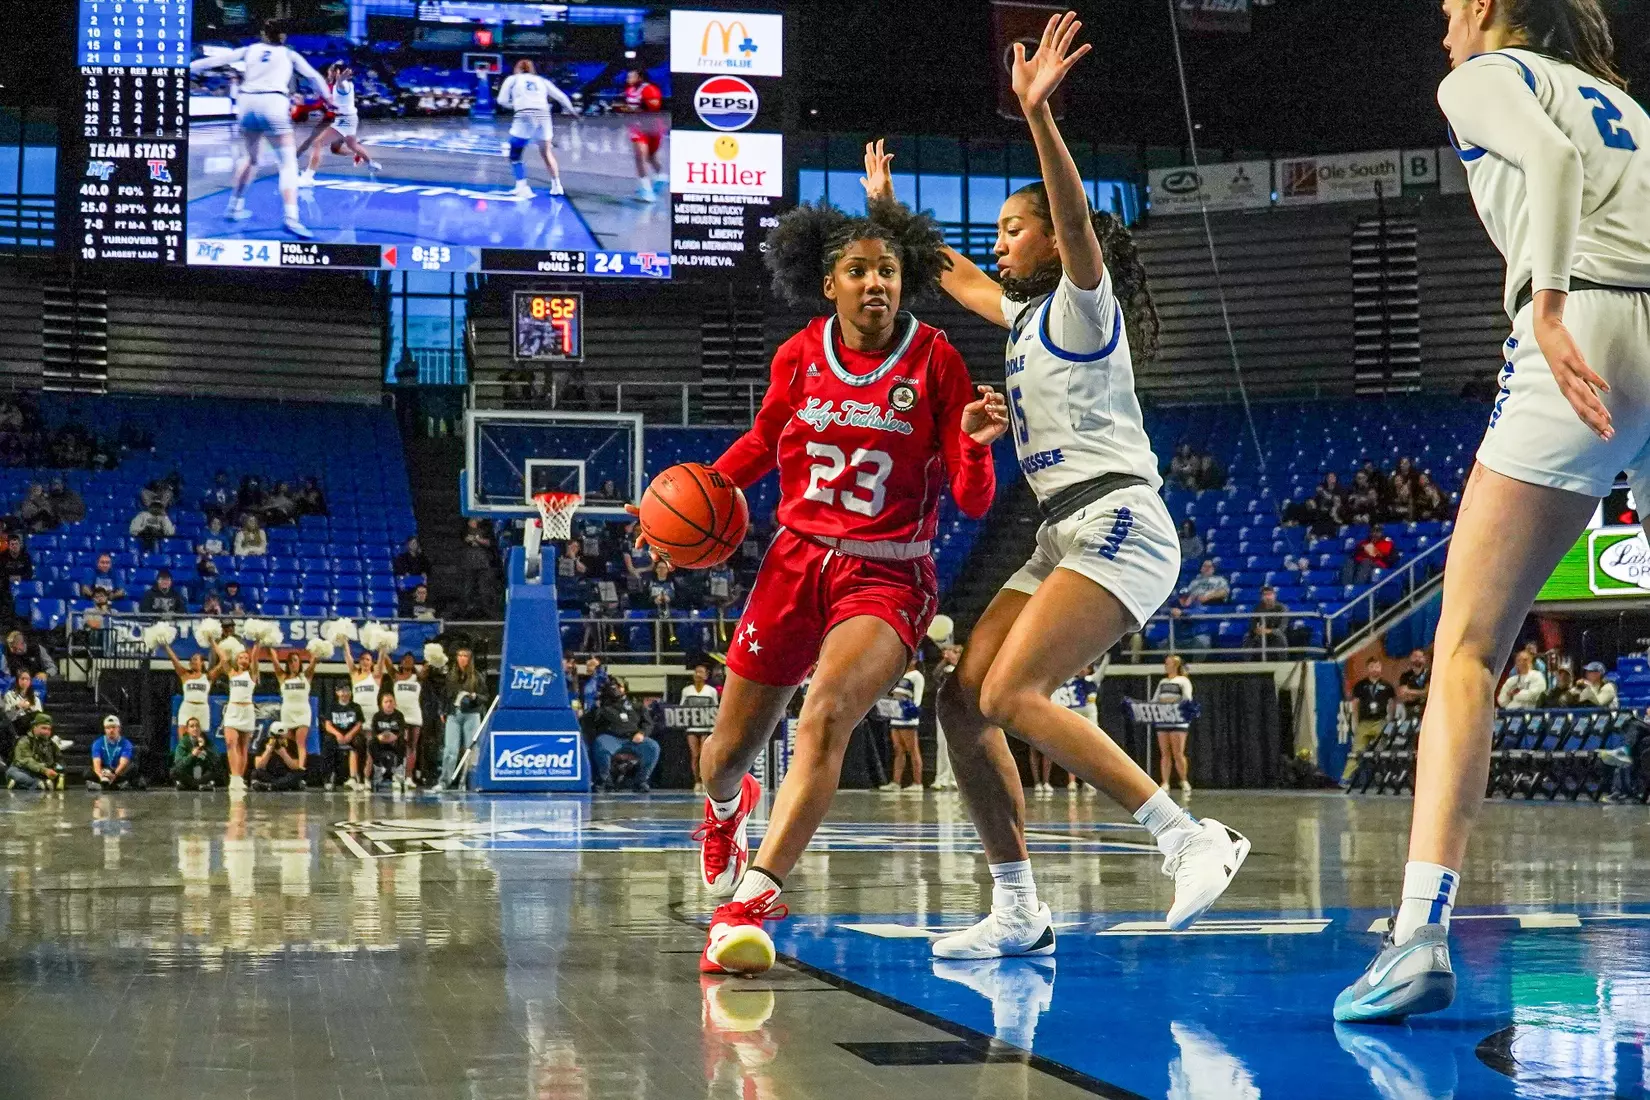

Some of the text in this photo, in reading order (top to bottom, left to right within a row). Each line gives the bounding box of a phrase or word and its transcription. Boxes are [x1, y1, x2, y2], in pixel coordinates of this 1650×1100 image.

[92, 3, 98, 12] 1
[138, 4, 144, 13] 1
[160, 5, 166, 14] 1
[178, 5, 185, 14] 2
[90, 16, 97, 25] 2
[112, 16, 125, 26] 11
[160, 17, 165, 26] 1
[178, 18, 184, 27] 1
[88, 28, 100, 37] 10
[178, 30, 184, 39] 1
[87, 41, 100, 50] 15
[137, 41, 143, 51] 1
[177, 42, 184, 52] 2
[87, 53, 99, 63] 21
[159, 55, 164, 64] 1
[177, 55, 184, 64] 2
[81, 67, 103, 75] PLYR
[108, 67, 124, 75] PTS
[130, 67, 147, 75] REB
[152, 68, 169, 76] AST
[89, 77, 96, 87] 3
[114, 77, 120, 87] 1
[176, 78, 184, 88] 2
[86, 89, 99, 99] 15
[112, 90, 120, 99] 3
[158, 91, 164, 100] 1
[176, 91, 184, 101] 2
[112, 102, 120, 112] 2
[135, 103, 142, 113] 2
[158, 103, 164, 113] 1
[177, 104, 183, 113] 1
[699, 97, 755, 110] PEPSI
[84, 114, 99, 124] 22
[112, 115, 120, 125] 5
[134, 115, 142, 125] 4
[158, 116, 164, 125] 1
[1578, 86, 1640, 152] 2
[84, 127, 98, 137] 23
[109, 127, 122, 137] 12
[135, 127, 141, 137] 1
[89, 143, 177, 159] TEAM STATS
[687, 162, 766, 186] Hiller
[1350, 159, 1396, 178] South
[80, 184, 182, 197] 40.0 FG% 22.7
[712, 195, 770, 205] BASKETBALL
[80, 202, 181, 214] 25.0 3PT% 44.4
[708, 205, 744, 215] KENTUCKY
[152, 220, 182, 231] 10-12
[709, 229, 744, 239] LIBERTY
[102, 235, 158, 245] TURNOVERS
[165, 235, 178, 247] 11
[81, 248, 175, 261] 10 LARGEST LEAD 2
[242, 245, 270, 261] 34
[283, 244, 303, 253] TOL
[311, 245, 318, 254] 4
[412, 245, 450, 262] 8:53
[283, 256, 315, 265] FOULS
[550, 252, 570, 262] TOL
[594, 253, 623, 273] 24
[538, 262, 569, 272] FOULS
[532, 298, 575, 319] 8:52
[551, 319, 571, 353] 7
[797, 396, 914, 435] Lady Techsters
[803, 441, 894, 517] 23
[664, 707, 717, 728] DEFENS
[496, 749, 574, 768] Ascend
